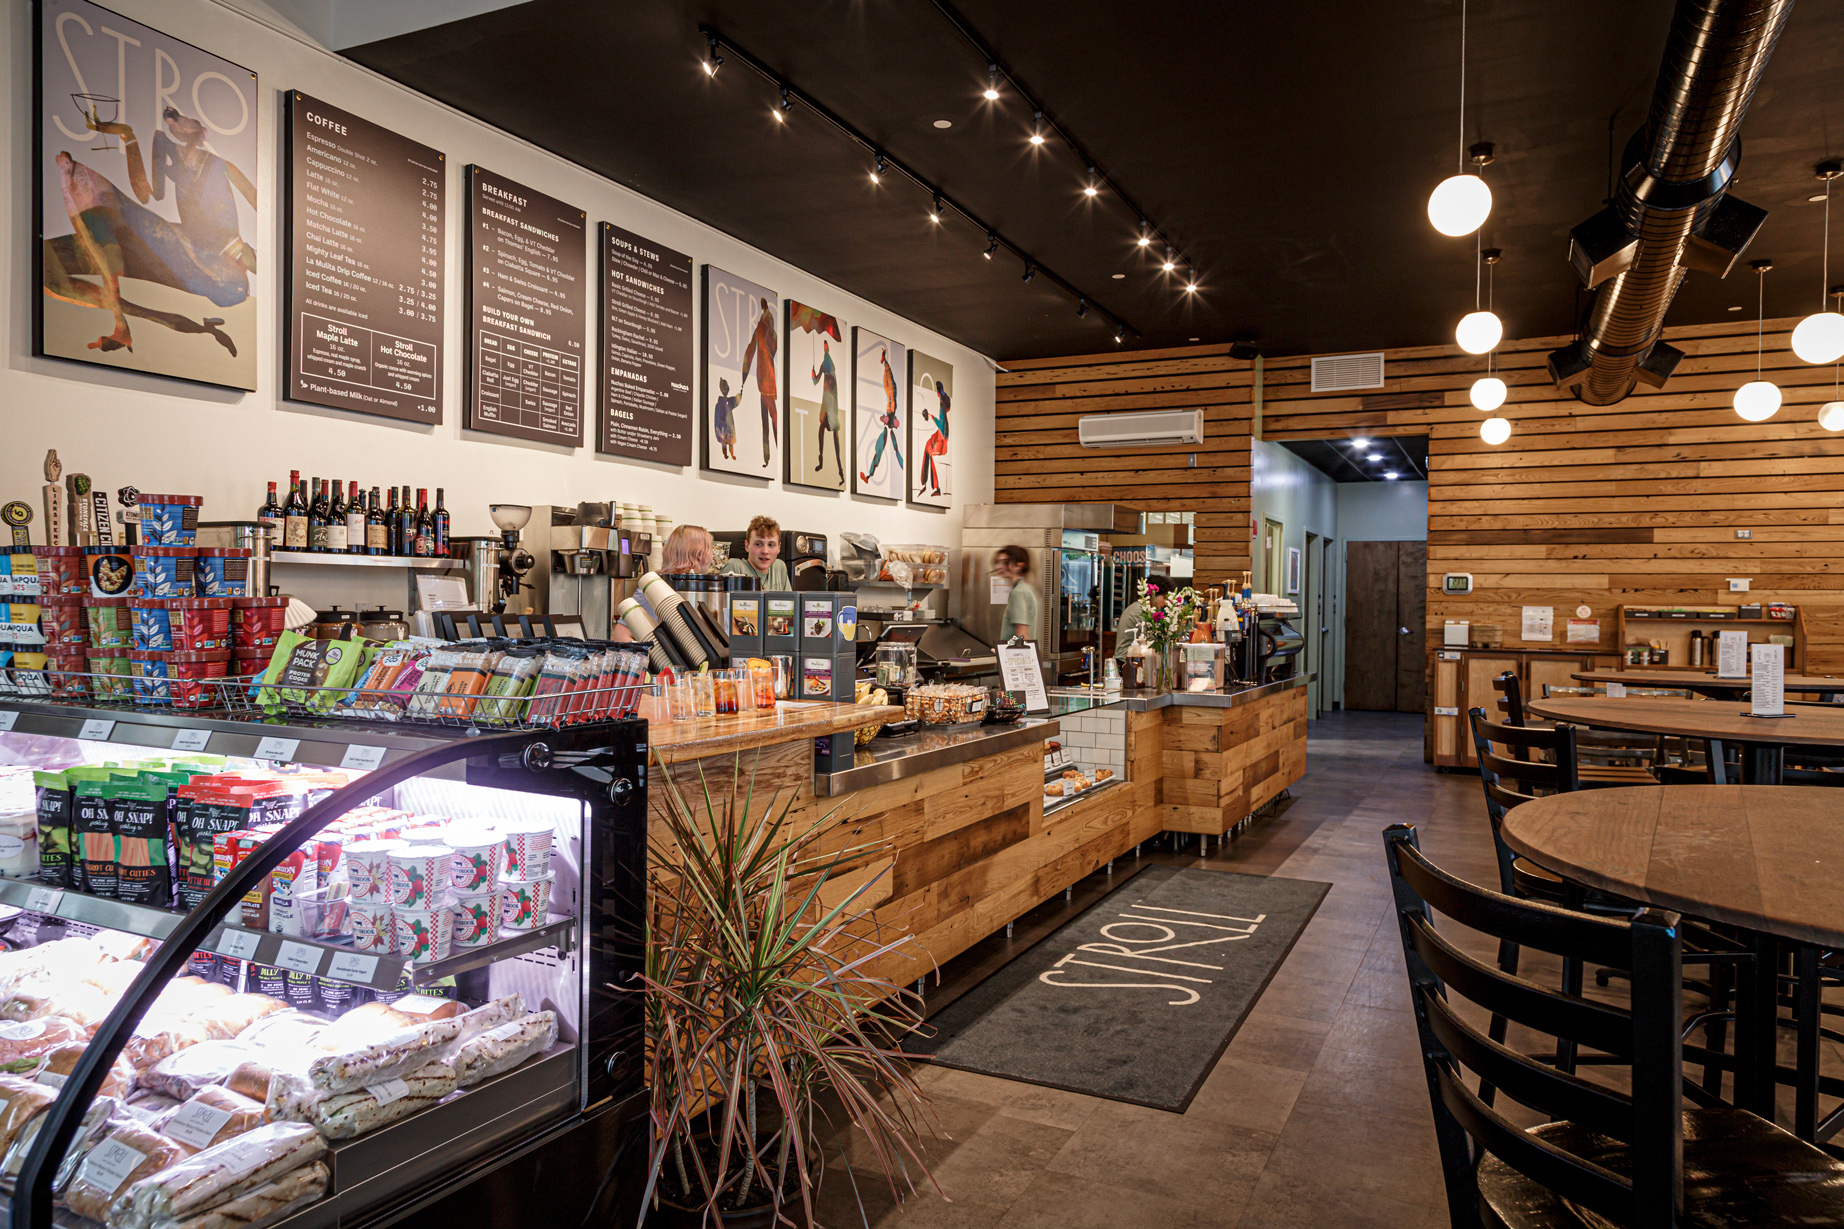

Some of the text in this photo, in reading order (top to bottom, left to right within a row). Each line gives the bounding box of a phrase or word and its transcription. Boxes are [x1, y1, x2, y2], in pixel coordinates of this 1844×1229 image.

[53, 12, 248, 154] STRO
[306, 112, 346, 135] COFFEE
[306, 131, 336, 148] Espresso
[337, 145, 353, 155] Double
[354, 152, 365, 160] Shot
[422, 177, 437, 188] 2.75
[306, 144, 341, 163] Americano
[422, 188, 437, 200] 2.75
[306, 156, 345, 176] Cappuccino
[422, 200, 437, 211] 4.00
[306, 168, 437, 222] Latte 4.00
[482, 182, 527, 207] BREAKFAST
[306, 181, 437, 233] Flat White 3.50
[306, 194, 437, 244] Mocha 4.75
[306, 206, 436, 255] Hot Chocolate 3.95
[482, 207, 518, 226] BREAKFAST
[520, 222, 558, 242] SANDWICHES
[306, 218, 436, 266] Matcha Latte 4.00
[497, 227, 513, 238] Bacon,
[514, 234, 524, 243] Egg,
[536, 242, 555, 253] Cheddar
[524, 245, 540, 256] English
[611, 236, 631, 250] SOUPS
[639, 248, 659, 261] STEWS
[306, 231, 436, 278] Chai Latte 4.50
[306, 243, 436, 289] Mighty Leaf Tea 3.00
[497, 249, 575, 281] Spinach, Egg, Tomato Cheddar
[306, 256, 436, 300] La Mulita Drip Coffee 2.75 3.25
[306, 268, 436, 311] Iced Coffee 3.25 4.00
[611, 269, 664, 294] HOT SANDWICHES
[305, 281, 436, 322] Iced Tea 3.00 3.75
[312, 300, 327, 308] drinks
[336, 307, 357, 316] available
[482, 305, 534, 326] BUILD YOUR OWN
[482, 315, 517, 331] BREAKFAST
[519, 326, 550, 340] SANDWICH
[316, 329, 358, 346] Maple Latte
[327, 324, 347, 335] Stroll
[380, 345, 426, 362] Hot Chocolate
[394, 340, 413, 351] Stroll
[328, 367, 345, 377] 4.50
[610, 366, 647, 382] EMPANADAS
[310, 383, 435, 413] Plant-based Milk +1.00
[395, 381, 411, 390] 4.50
[610, 408, 633, 420] BAGELS
[95, 497, 111, 533] CITIZEN
[292, 657, 316, 668] PACK
[296, 649, 319, 660] MUNK
[289, 670, 311, 678] PROTEIN
[996, 690, 1014, 698] FREE
[42, 800, 63, 812] SNAP!
[81, 808, 94, 819] OH
[114, 810, 154, 824] OH SNAP!
[176, 811, 187, 822] OH
[192, 817, 204, 828] OH
[42, 854, 62, 862] ITES
[130, 869, 156, 877] CUTIES
[1039, 903, 1266, 1006] STROLL
